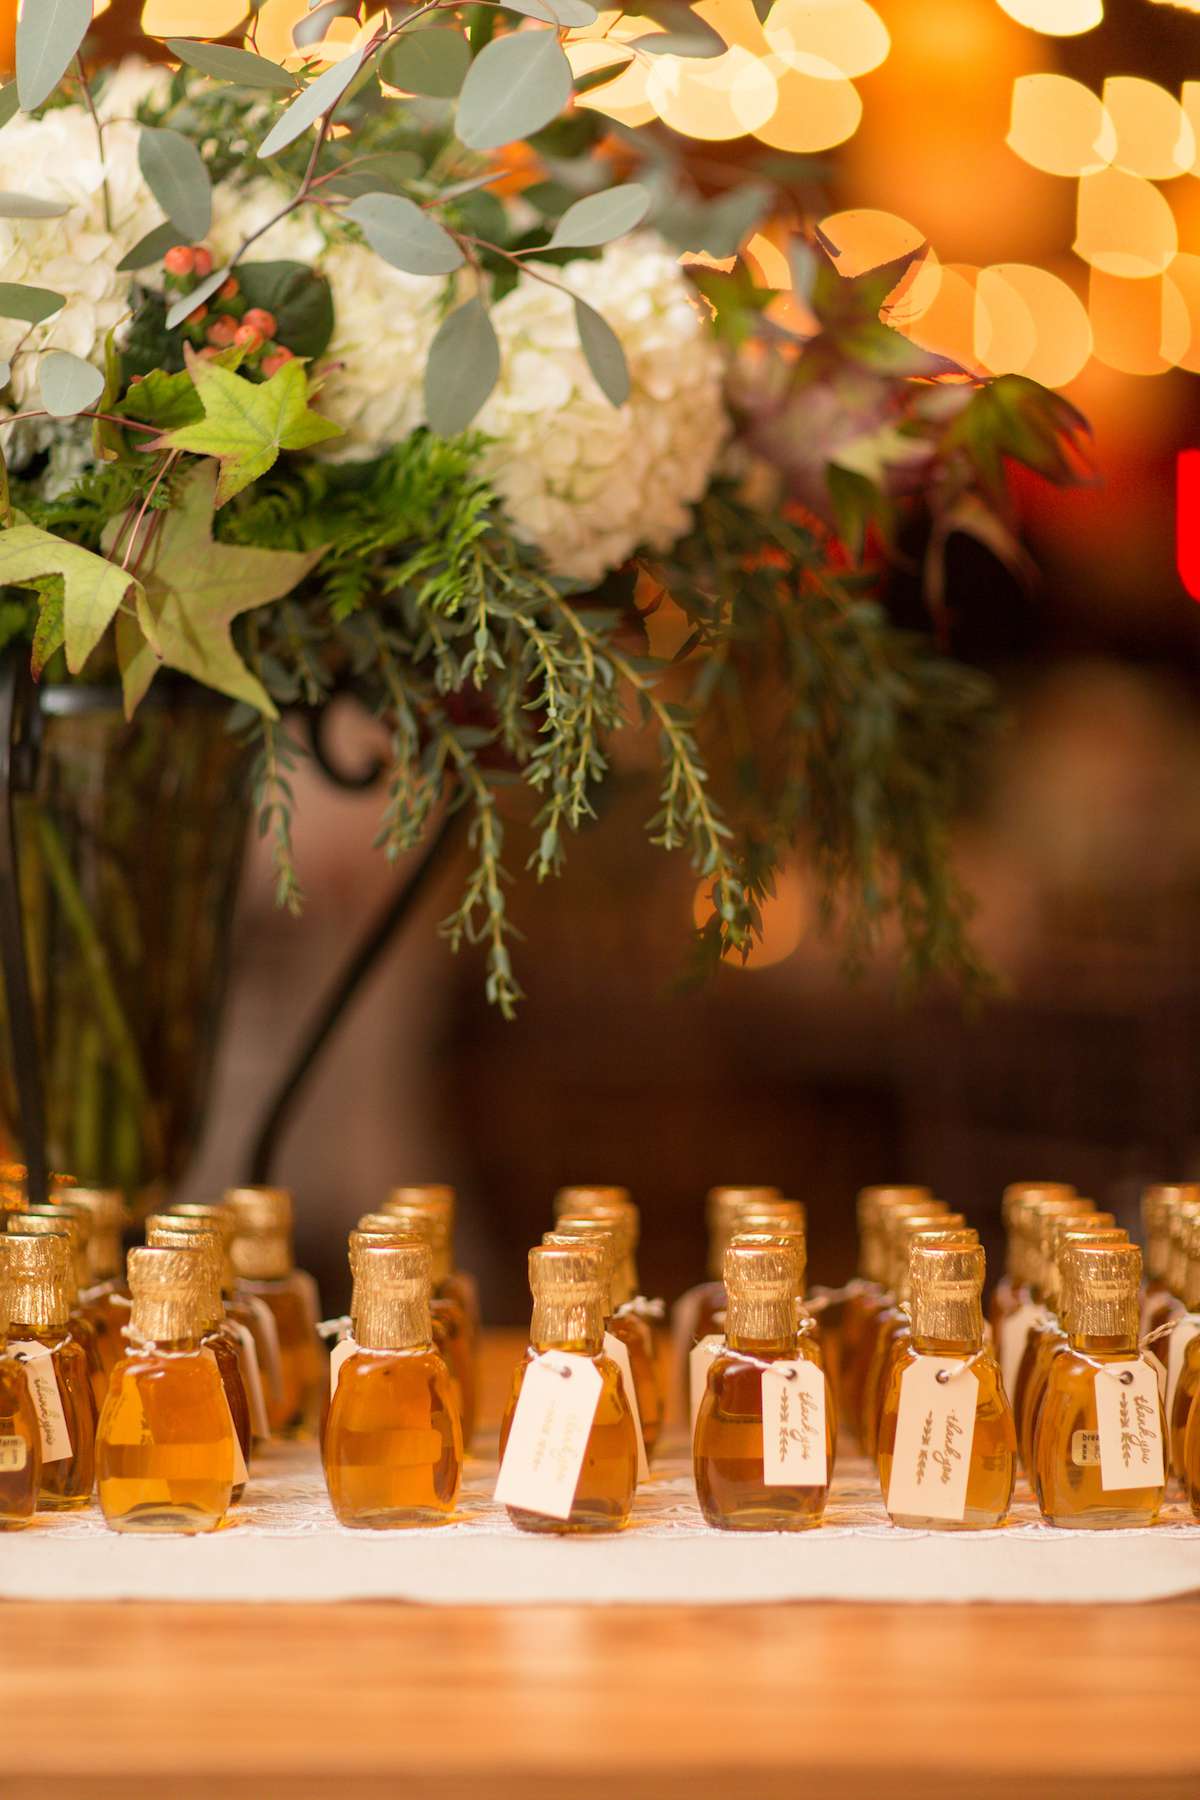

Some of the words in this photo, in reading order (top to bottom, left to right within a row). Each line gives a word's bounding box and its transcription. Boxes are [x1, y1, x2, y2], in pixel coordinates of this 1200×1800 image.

[798, 1391, 818, 1434] thank
[1133, 1395, 1158, 1439] thank
[789, 1427, 810, 1461] you
[945, 1415, 964, 1460] thank
[1130, 1434, 1151, 1465] you
[932, 1450, 953, 1484] you
